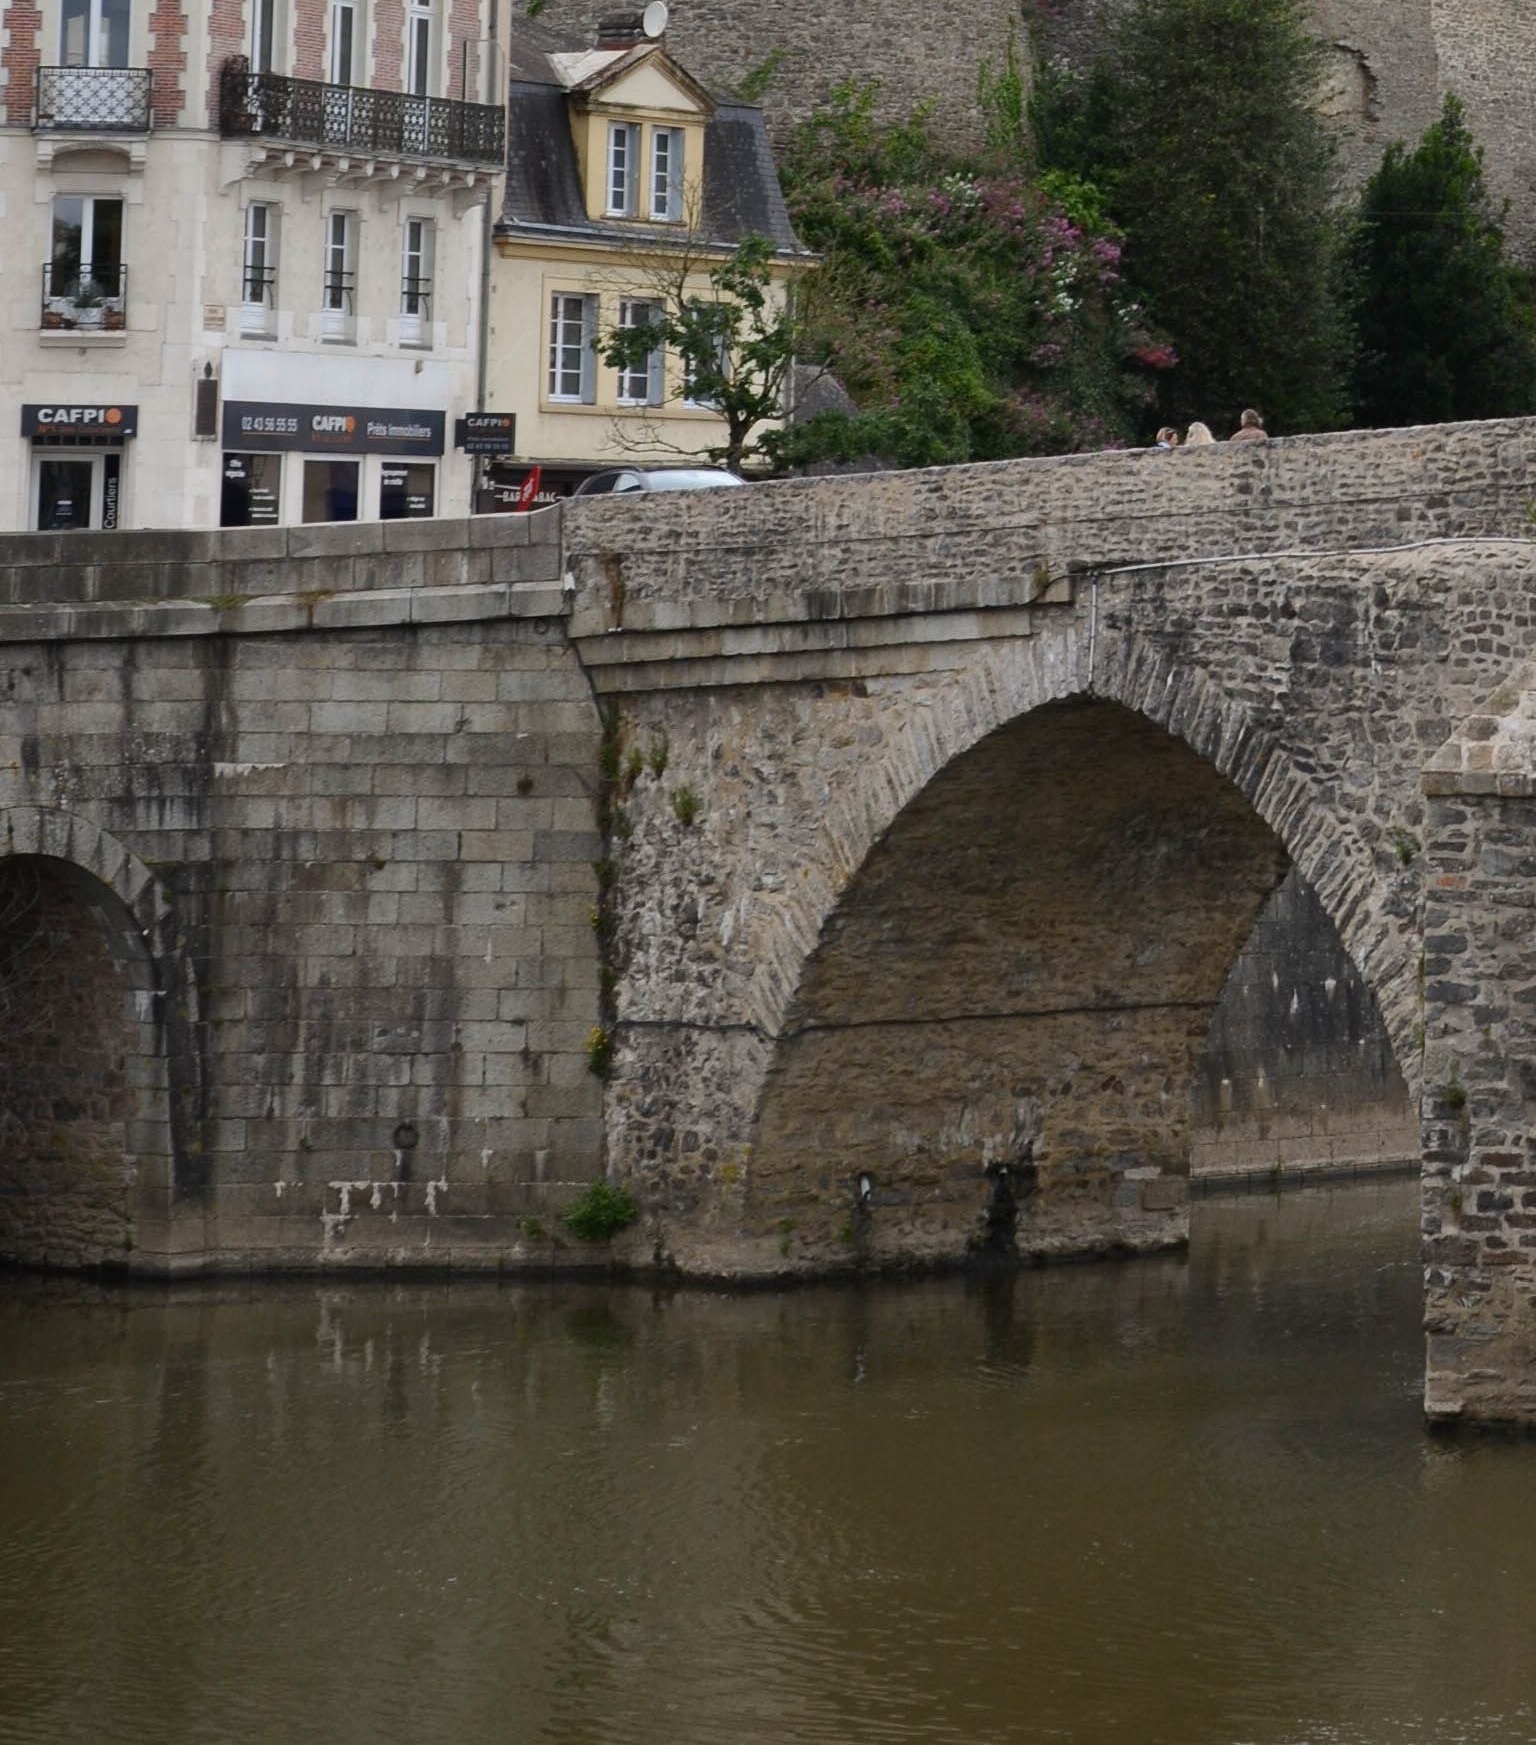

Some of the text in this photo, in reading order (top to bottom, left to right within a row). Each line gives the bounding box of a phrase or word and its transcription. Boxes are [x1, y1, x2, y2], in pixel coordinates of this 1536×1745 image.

[38, 408, 105, 423] CAFPI
[312, 415, 346, 431] CAFPI
[467, 418, 502, 427] CAFPI
[104, 477, 118, 529] Courtiers
